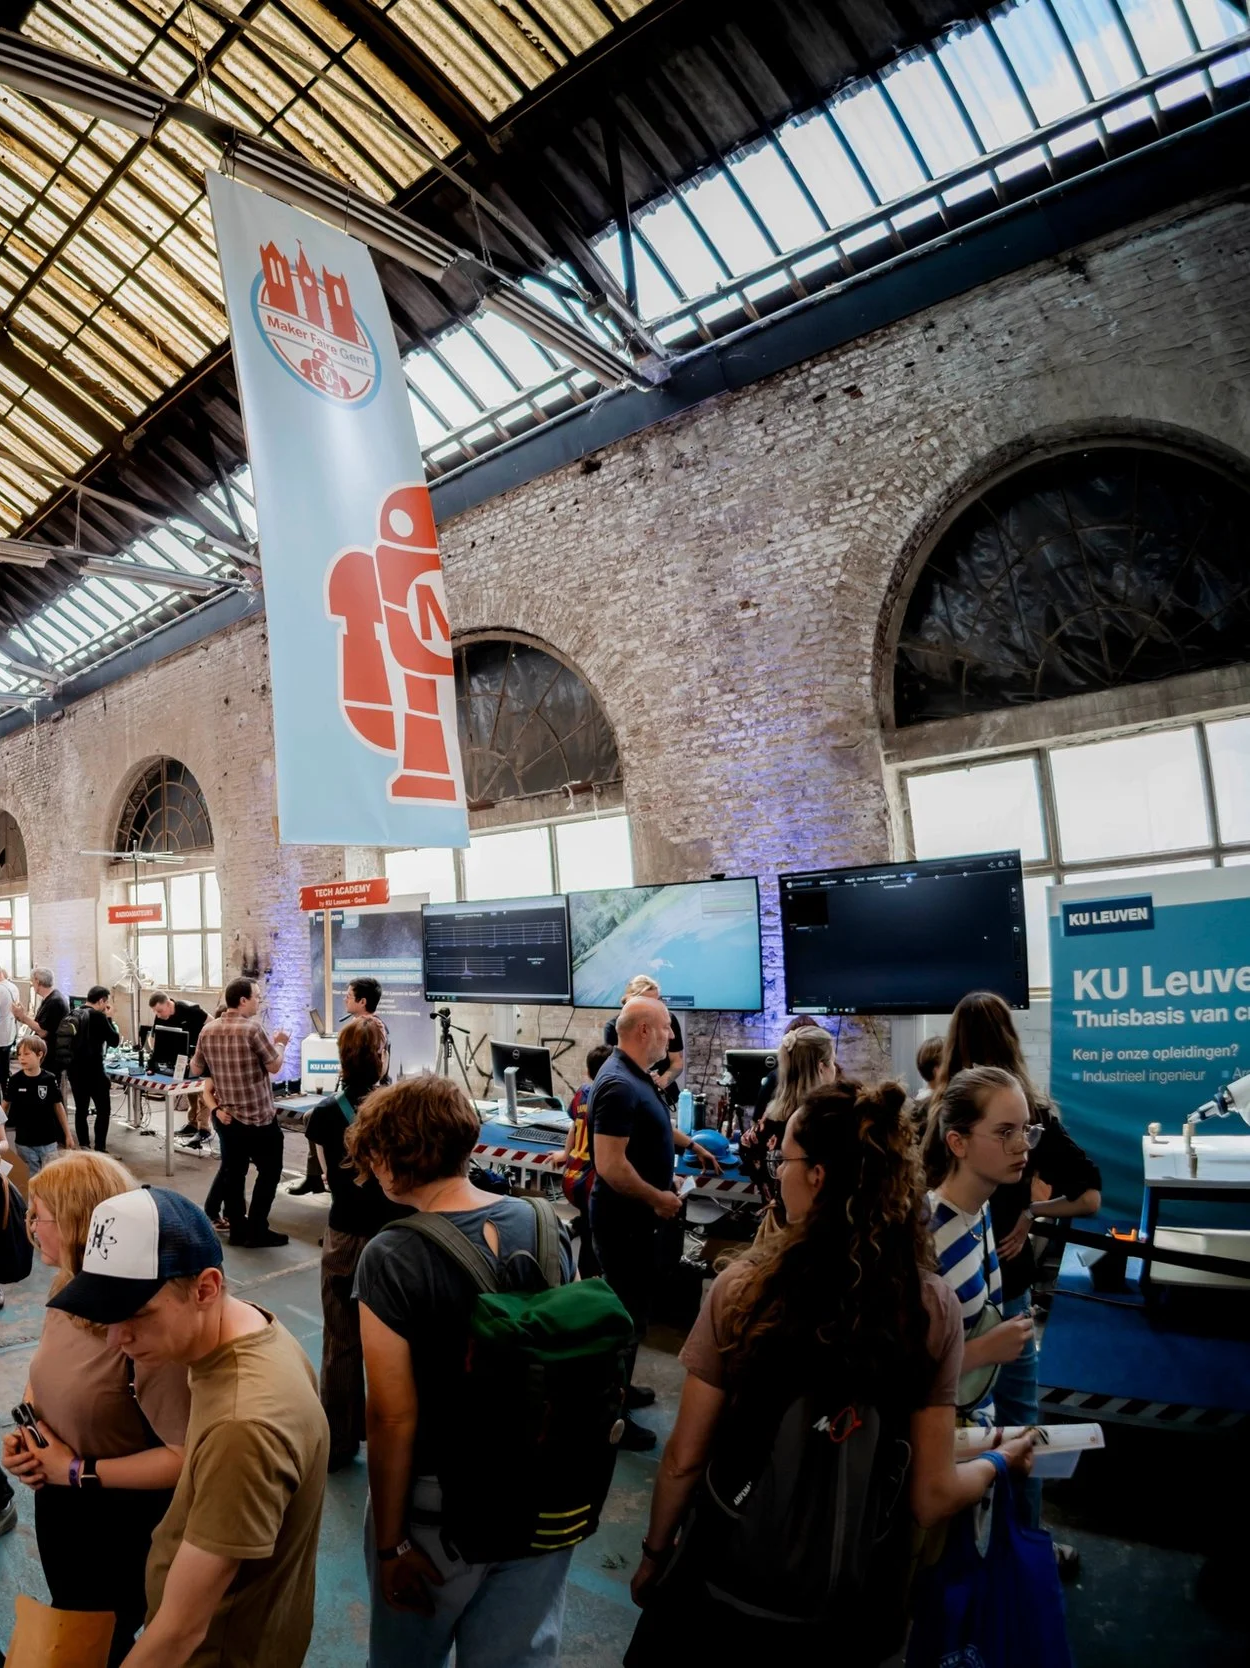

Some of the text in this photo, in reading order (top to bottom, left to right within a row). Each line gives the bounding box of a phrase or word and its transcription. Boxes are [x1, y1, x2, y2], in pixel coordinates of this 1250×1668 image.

[267, 314, 370, 368] Maker Faire Gent
[314, 884, 371, 897] TECH ACADEMY
[1068, 907, 1148, 926] KU LEUVEN
[1073, 965, 1250, 1000] KU Leuve
[1072, 1007, 1185, 1028] Thuisbasis
[1190, 1008, 1228, 1023] van
[1073, 1043, 1239, 1063] Ken je onze opleidingen?
[1083, 1069, 1145, 1083] Industrieel
[1149, 1069, 1206, 1085] ingenieur
